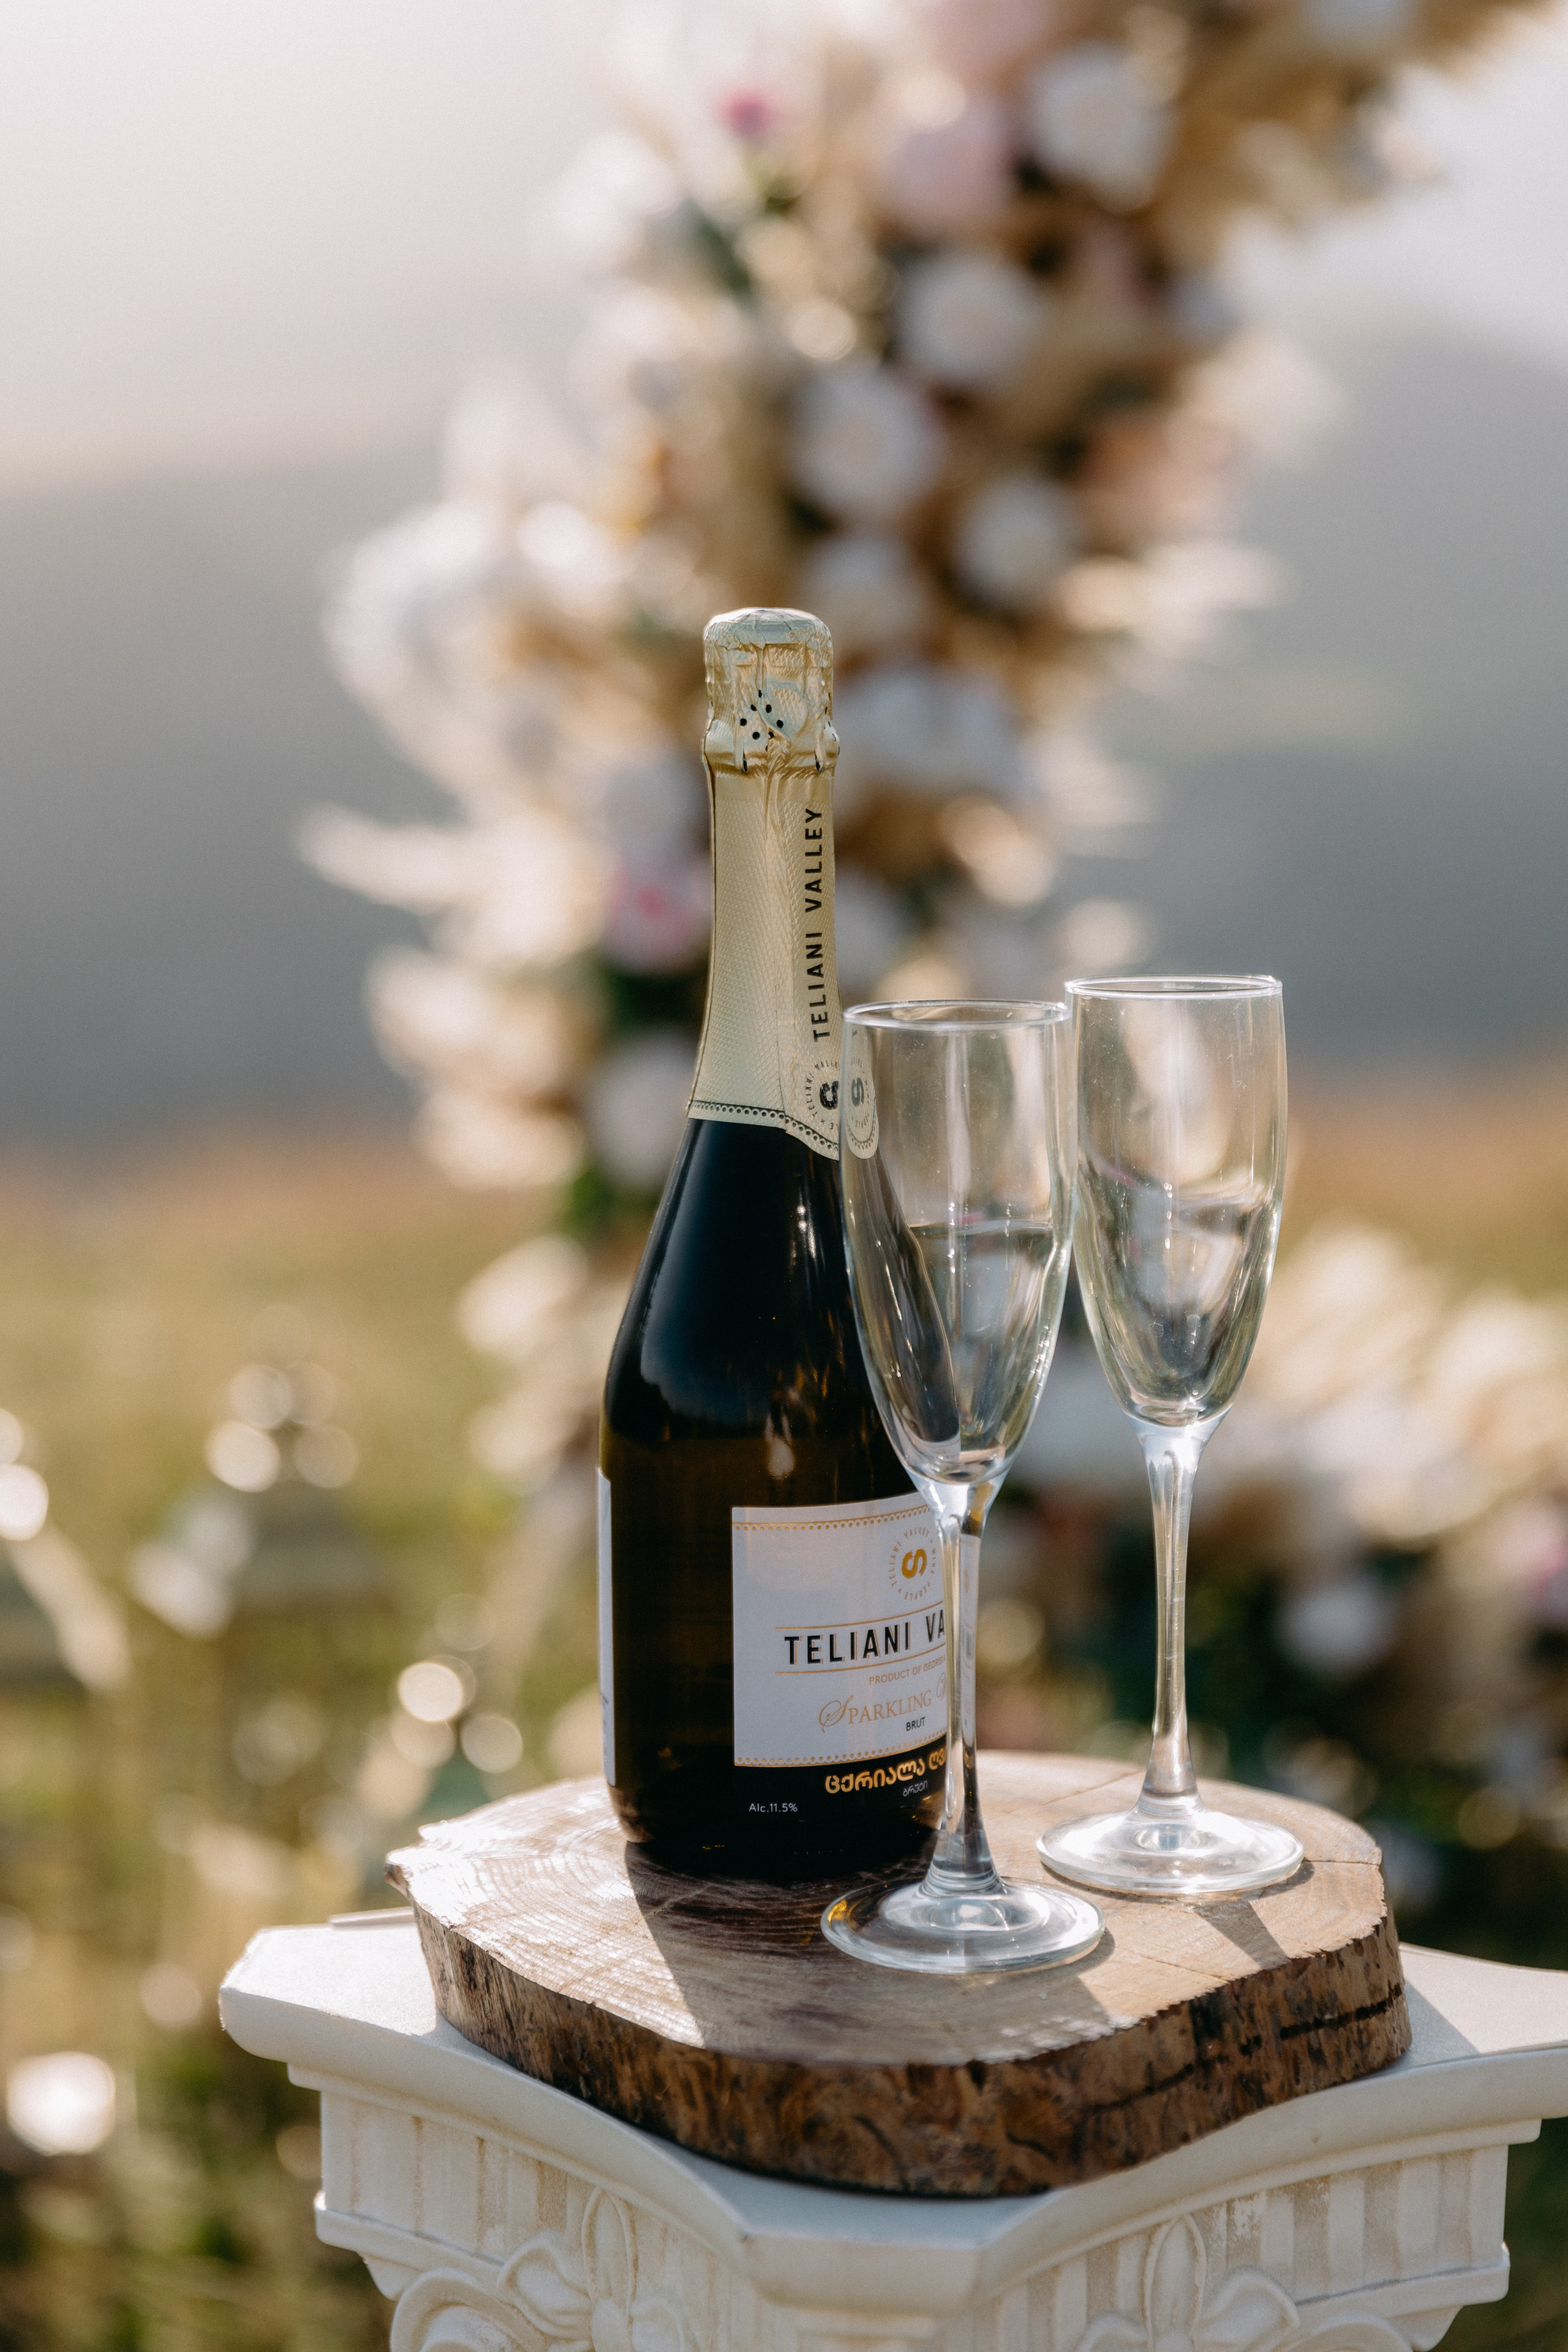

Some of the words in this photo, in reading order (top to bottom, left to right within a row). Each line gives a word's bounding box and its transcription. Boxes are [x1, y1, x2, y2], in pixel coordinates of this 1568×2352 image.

[805, 808, 823, 913] VALLEY
[806, 932, 831, 1043] TELIANI
[805, 1072, 818, 1118] TELIANI
[815, 1059, 840, 1071] VALLE
[889, 1541, 902, 1587] TELIANI
[903, 1526, 930, 1539] VALLEY
[784, 1621, 911, 1665] TELIANI
[925, 1609, 944, 1643] VA
[869, 1668, 910, 1686] PRODUCT
[911, 1664, 922, 1676] OF
[906, 1717, 925, 1732] BRUT
[825, 1758, 925, 1794] ცქრიალა
[748, 1803, 798, 1813] Alc.11.5%
